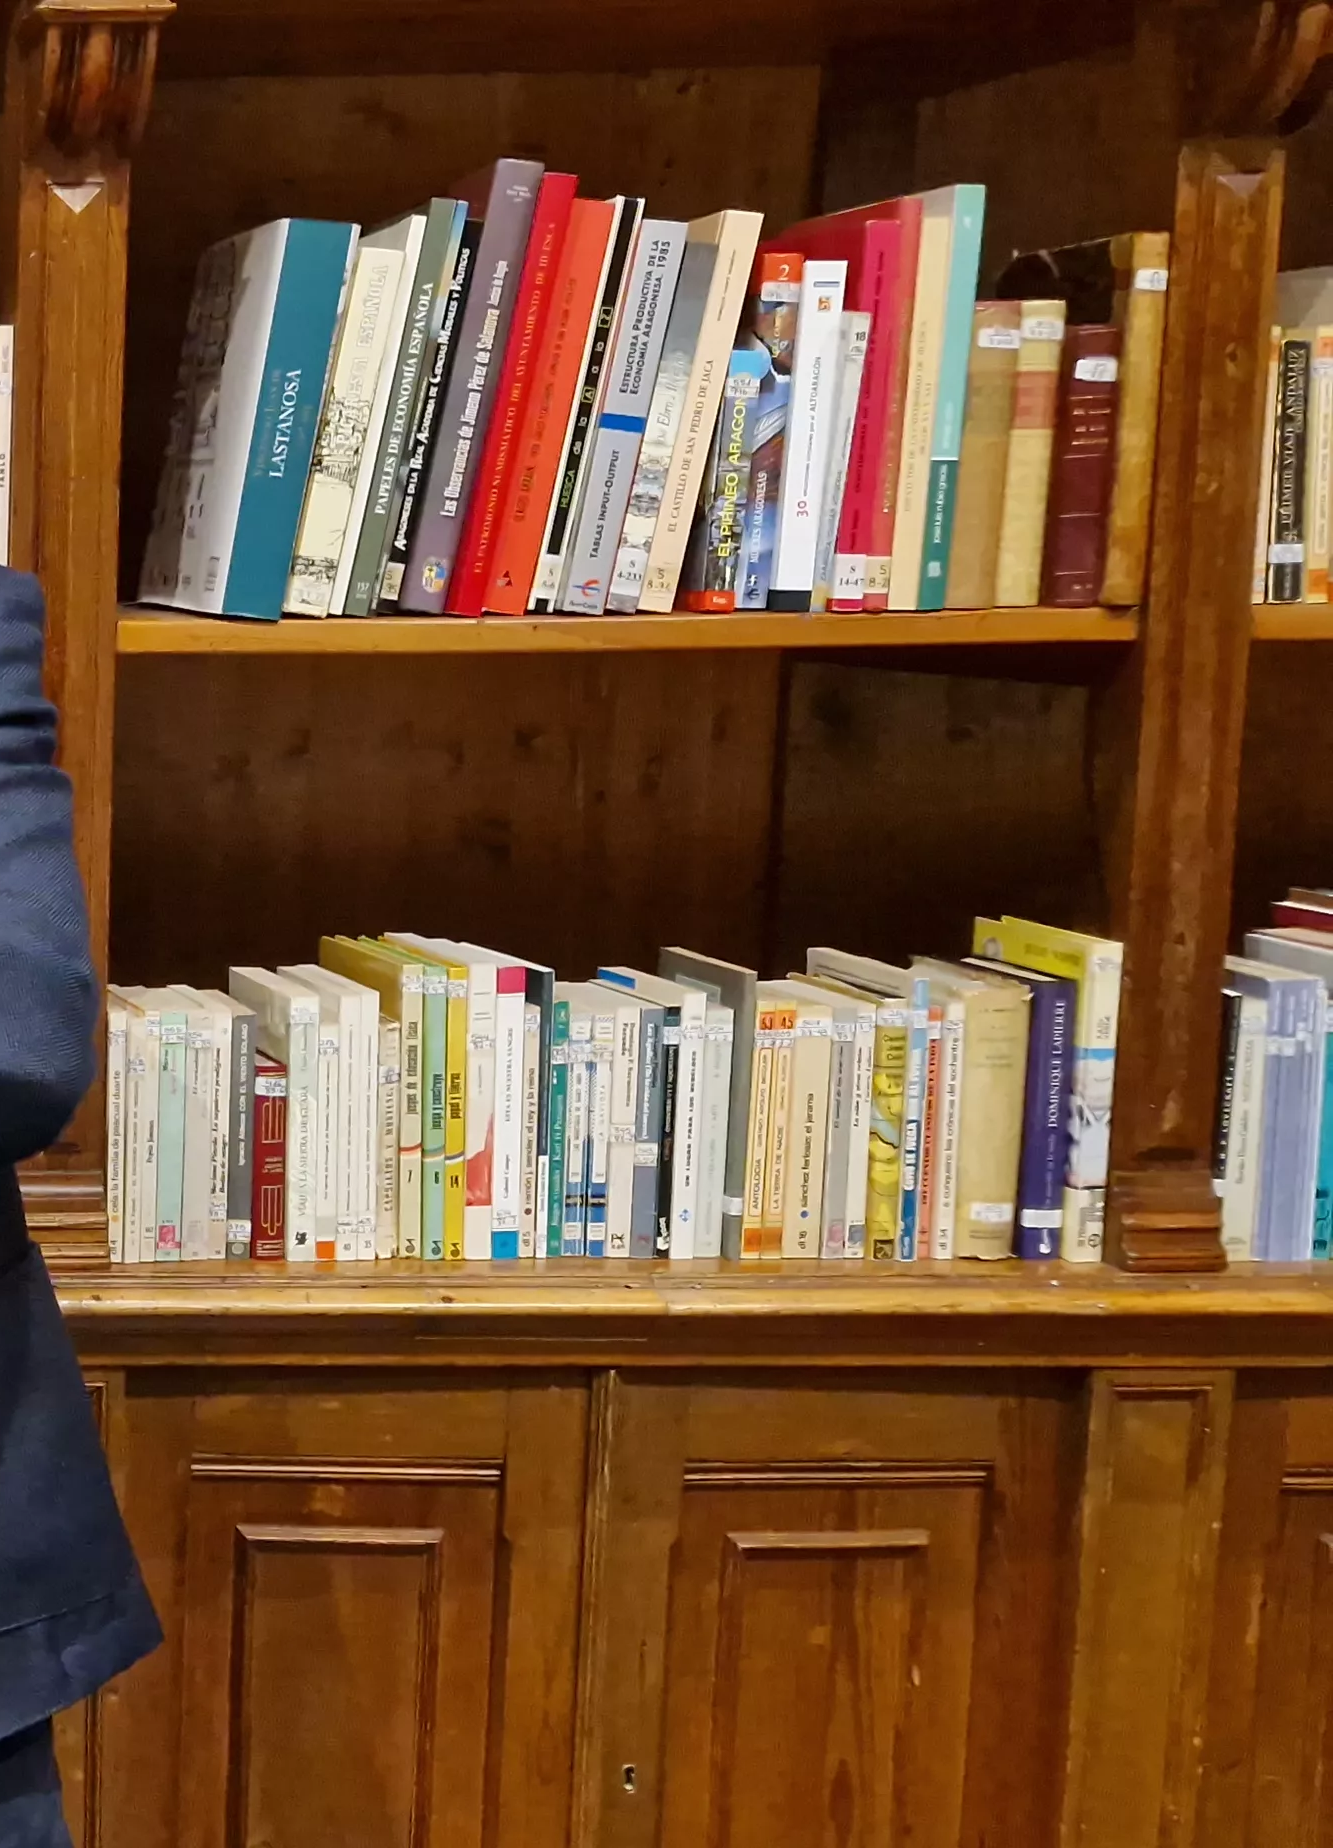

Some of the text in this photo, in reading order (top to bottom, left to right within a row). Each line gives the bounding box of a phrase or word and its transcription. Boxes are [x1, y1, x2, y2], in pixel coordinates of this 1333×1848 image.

[646, 254, 656, 267] DE
[649, 239, 659, 251] LA
[655, 240, 670, 268] 1985
[778, 264, 789, 280] 2
[355, 265, 388, 348] ESPAÑOLA
[855, 331, 866, 341] 18
[269, 369, 301, 477] LASTANOSA
[374, 282, 433, 514] PAPELES DE ECONOMÍA ESPAÑOLA
[477, 271, 544, 556] PATRIMONIO DEL DE
[439, 350, 490, 517] Las Observancias de Jimeno Pérez de
[559, 341, 604, 508] HUESCA de la A la
[666, 359, 714, 533] EL CASTILLO DE SAN PEDRO DE JACA
[408, 445, 425, 469] REAL
[716, 472, 738, 556] EL PIRINEO
[752, 471, 767, 526] ARAGONESAS
[796, 500, 808, 517] 30
[1051, 1001, 1065, 1054] LAPIERRE
[111, 1070, 120, 1100] duarte
[238, 1023, 248, 1111] CON EL VIENTO SOLANO
[527, 1067, 535, 1089] reina
[1047, 1059, 1061, 1126] DOMINIQUE
[112, 1102, 121, 1136] pascual
[298, 1085, 309, 1180] LA SIERRA DE GUARA
[525, 1125, 534, 1133] el
[527, 1110, 535, 1123] rey
[944, 1083, 955, 1151] las del
[110, 1138, 118, 1149] de
[110, 1151, 118, 1181] familia
[525, 1137, 533, 1166] sender:
[800, 1093, 814, 1207] sánchez el jarama
[524, 1176, 532, 1204] ramón
[752, 1158, 761, 1209] ANTOLOGIA
[772, 1154, 781, 1209] LA DE
